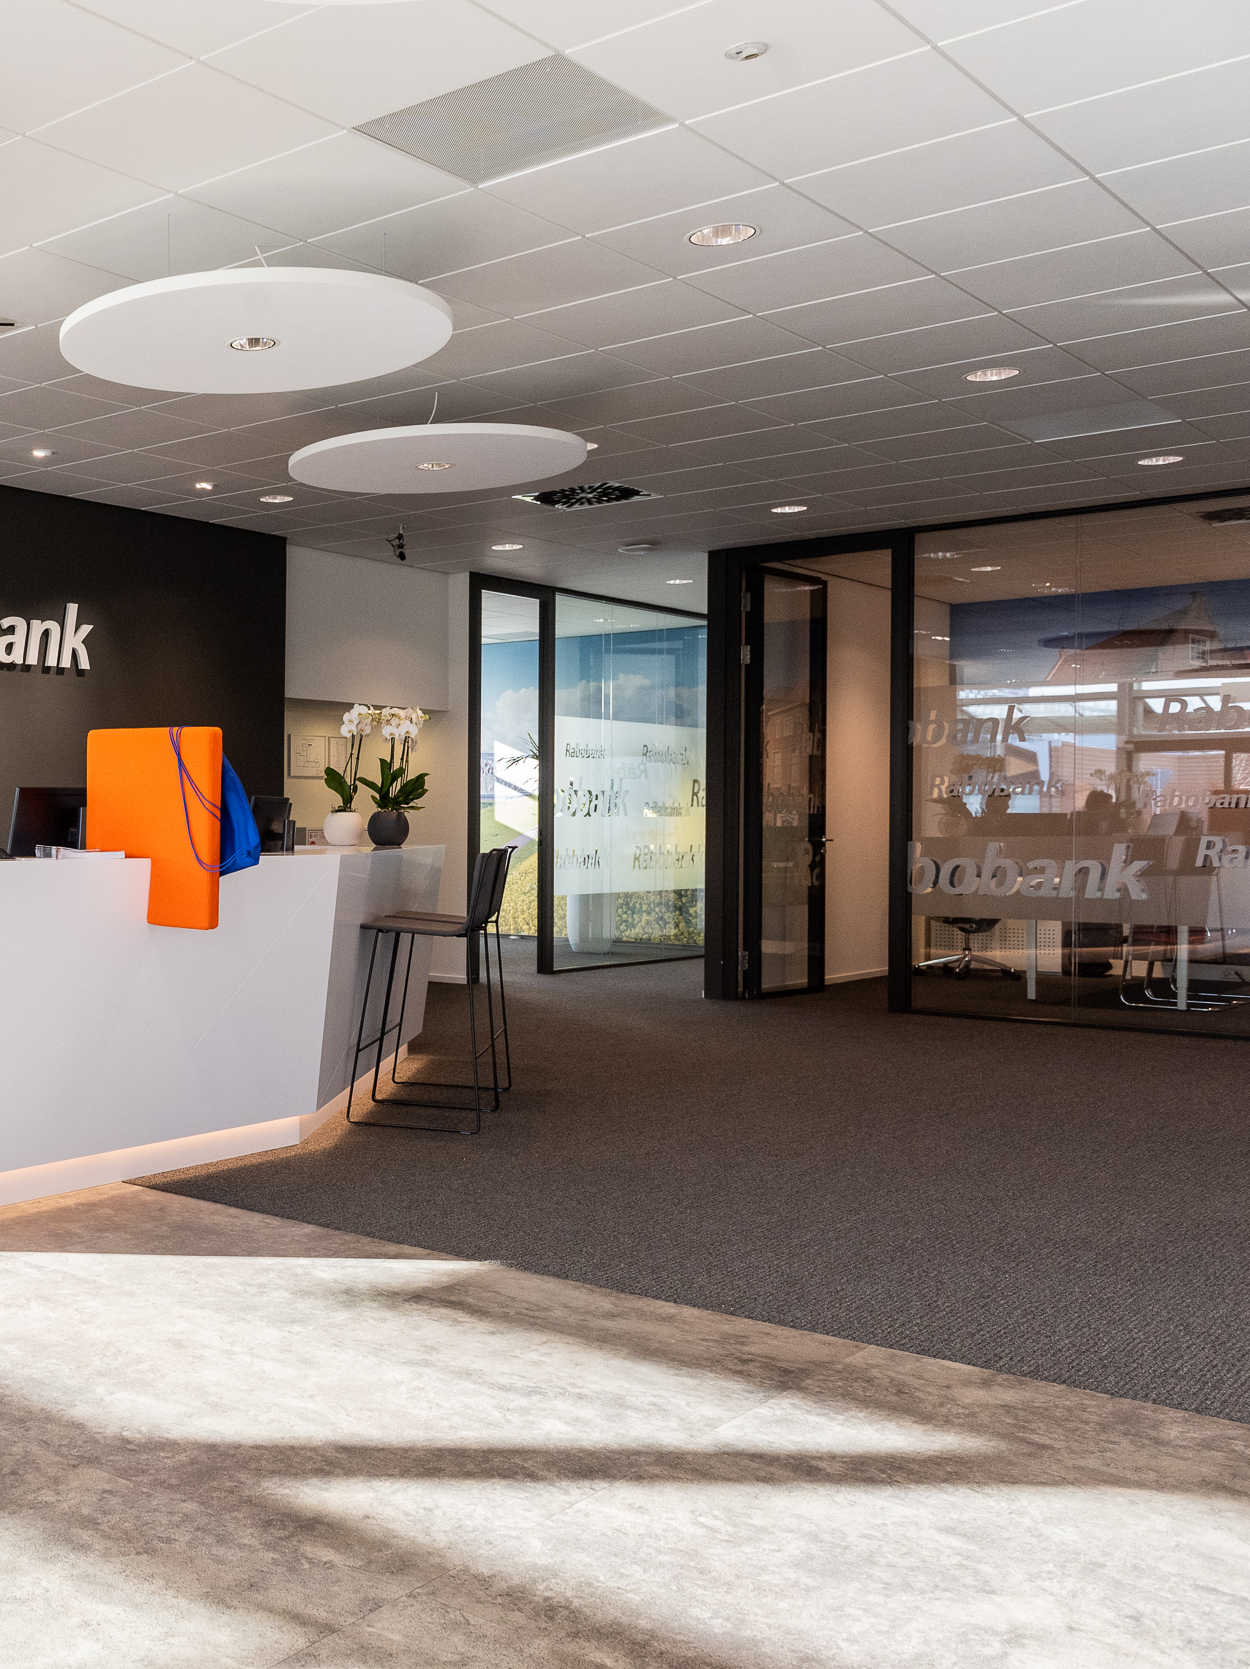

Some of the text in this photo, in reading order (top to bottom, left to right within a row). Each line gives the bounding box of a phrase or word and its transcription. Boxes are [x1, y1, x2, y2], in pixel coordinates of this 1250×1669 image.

[1158, 694, 1250, 733] Rab
[928, 773, 1063, 798] Rabobank
[1142, 788, 1250, 809] Raboban
[907, 840, 1153, 901] bobank
